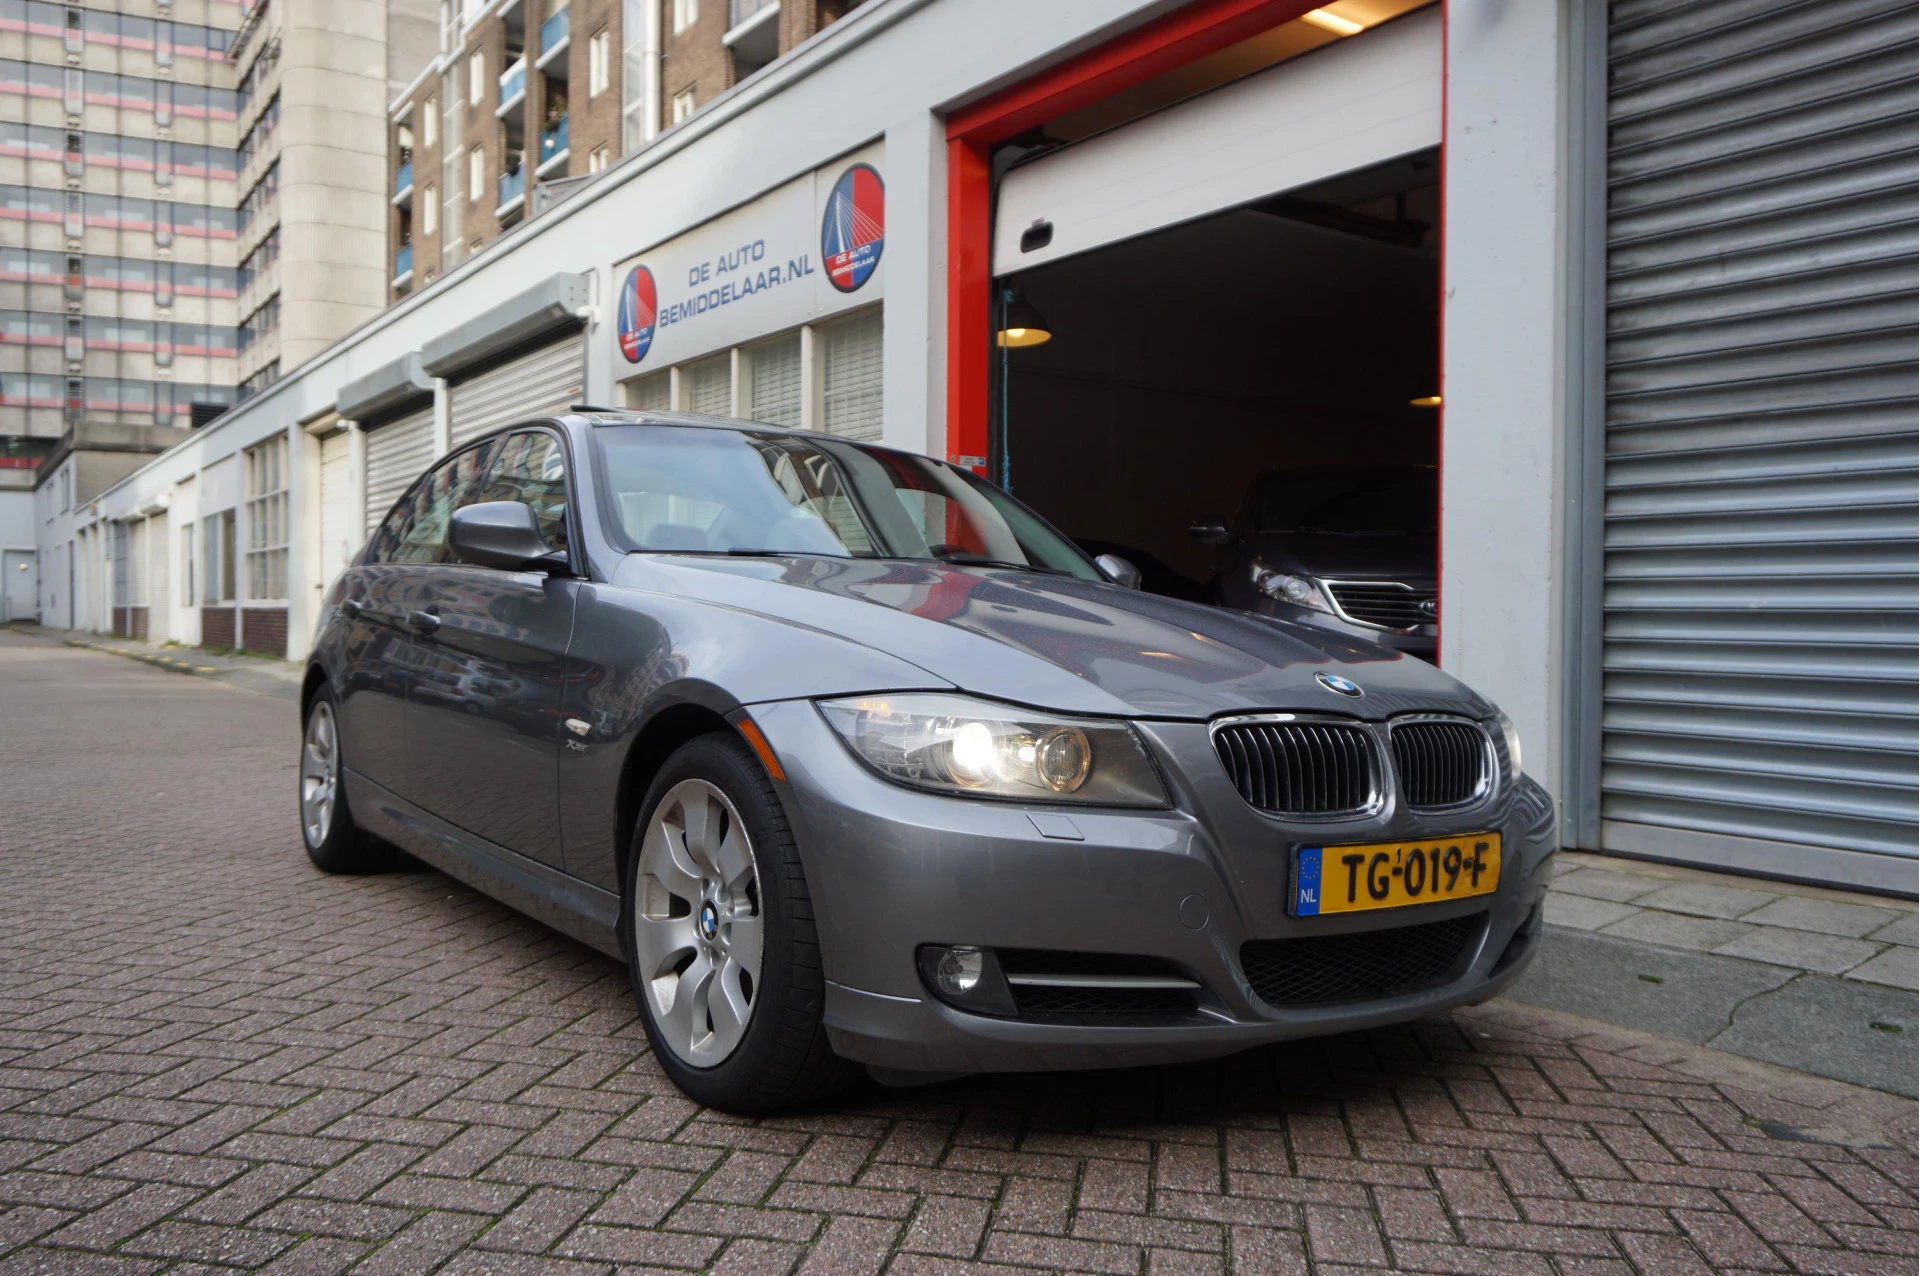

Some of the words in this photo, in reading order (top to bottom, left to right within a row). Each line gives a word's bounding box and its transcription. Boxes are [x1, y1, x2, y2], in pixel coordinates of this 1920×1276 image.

[688, 263, 711, 287] DE
[715, 238, 765, 277] AUTO
[835, 252, 848, 264] DE
[848, 244, 871, 260] AUTO
[659, 254, 814, 327] BEMIDDELAAR.NL
[1300, 887, 1317, 904] NL
[1342, 842, 1489, 903] TG-019-F
